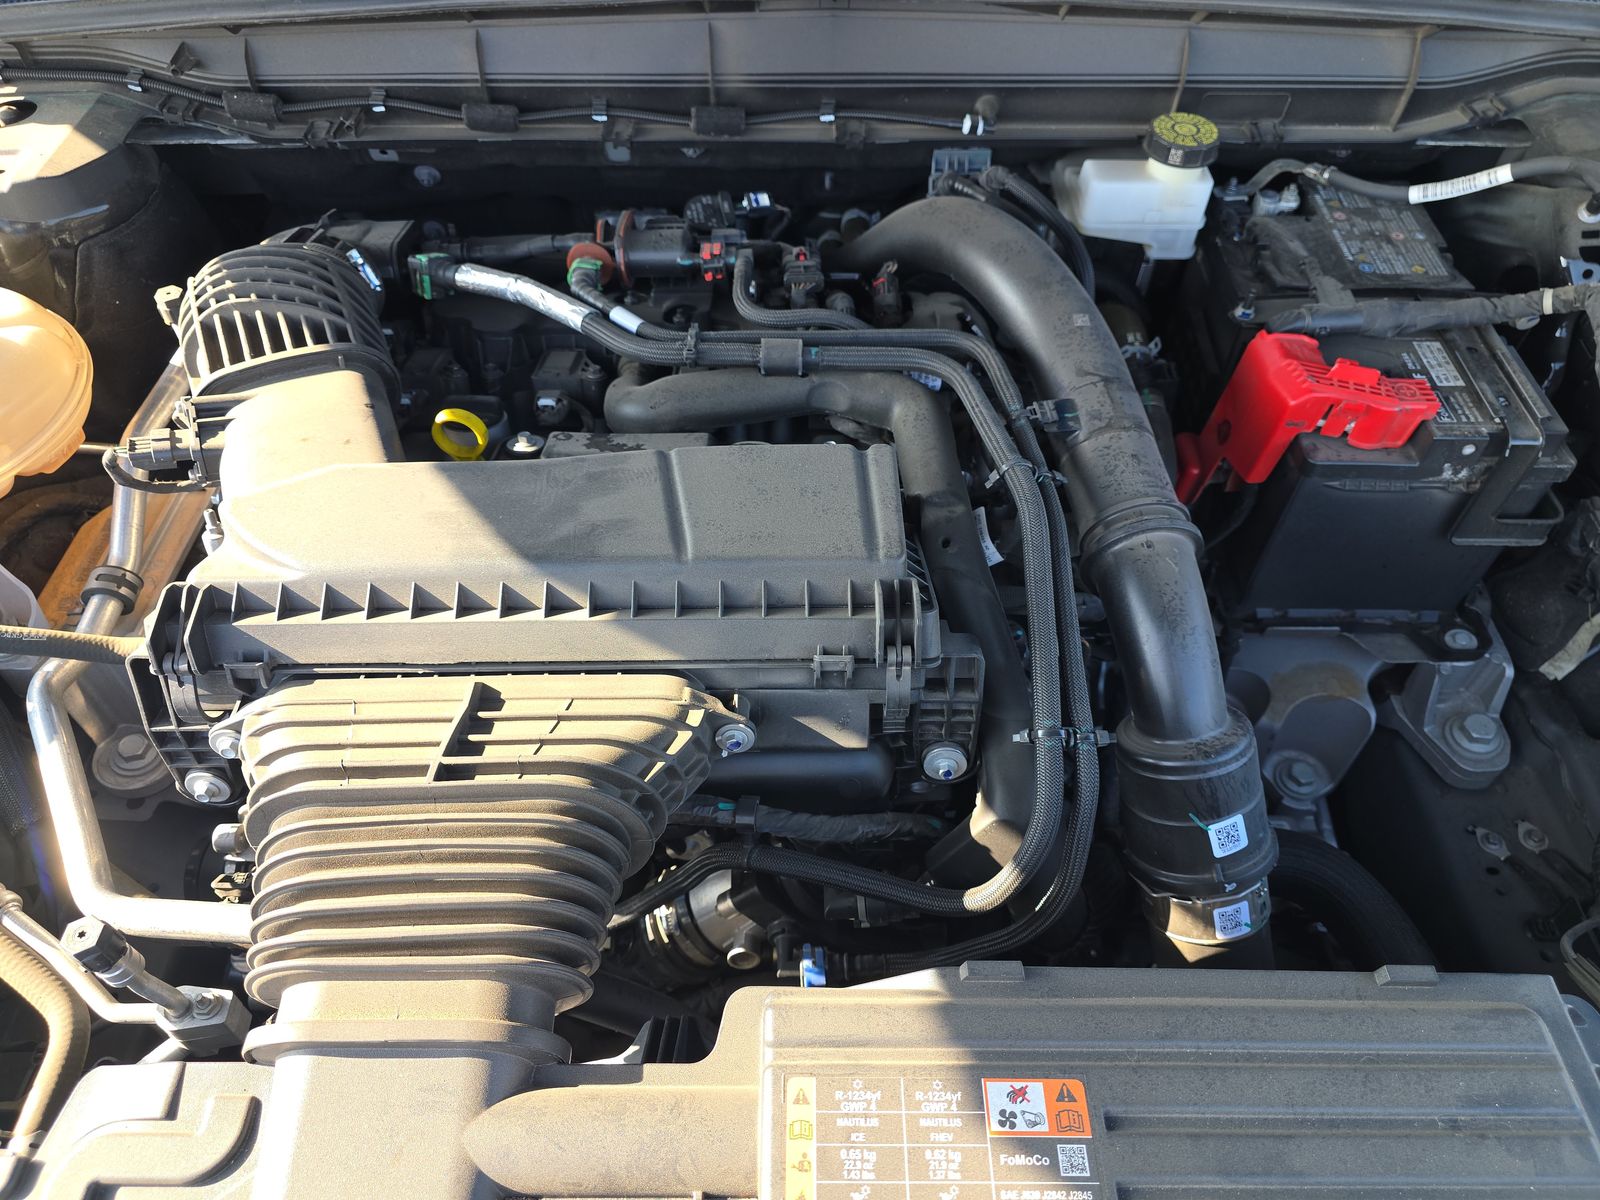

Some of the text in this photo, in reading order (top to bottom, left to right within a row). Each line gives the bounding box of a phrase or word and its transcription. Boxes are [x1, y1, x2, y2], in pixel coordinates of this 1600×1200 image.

[835, 1091, 881, 1102] R-1234yf
[915, 1091, 961, 1102] R-1234yf
[841, 1102, 877, 1111] GWP 4
[921, 1102, 958, 1112] GWP 4
[837, 1118, 879, 1127] NAUTILUS
[919, 1118, 962, 1127] NAUTILUS
[850, 1133, 866, 1141] ICE
[930, 1133, 953, 1141] FHEV
[863, 1149, 876, 1162] kg
[948, 1149, 961, 1162] kg
[1000, 1154, 1050, 1165] FoMoCo
[1068, 1191, 1092, 1200] J2845
